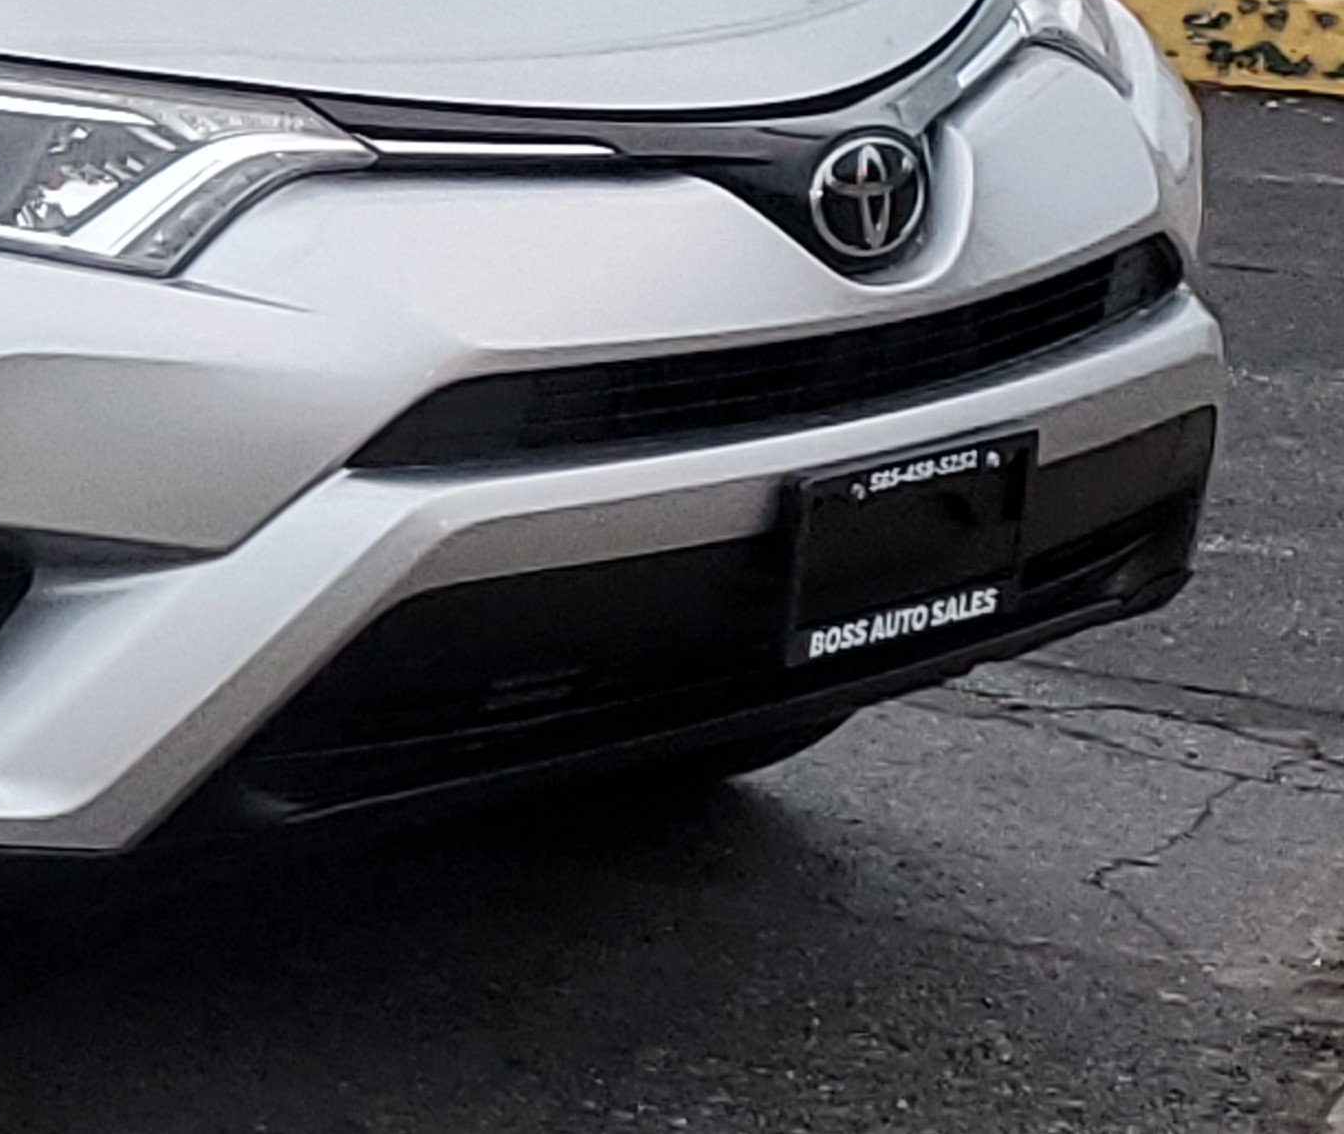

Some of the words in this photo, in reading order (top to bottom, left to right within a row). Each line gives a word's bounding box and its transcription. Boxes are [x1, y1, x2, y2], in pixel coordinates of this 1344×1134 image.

[809, 619, 868, 658] BOSS
[869, 604, 929, 643] AUTO
[930, 587, 999, 627] SALES
